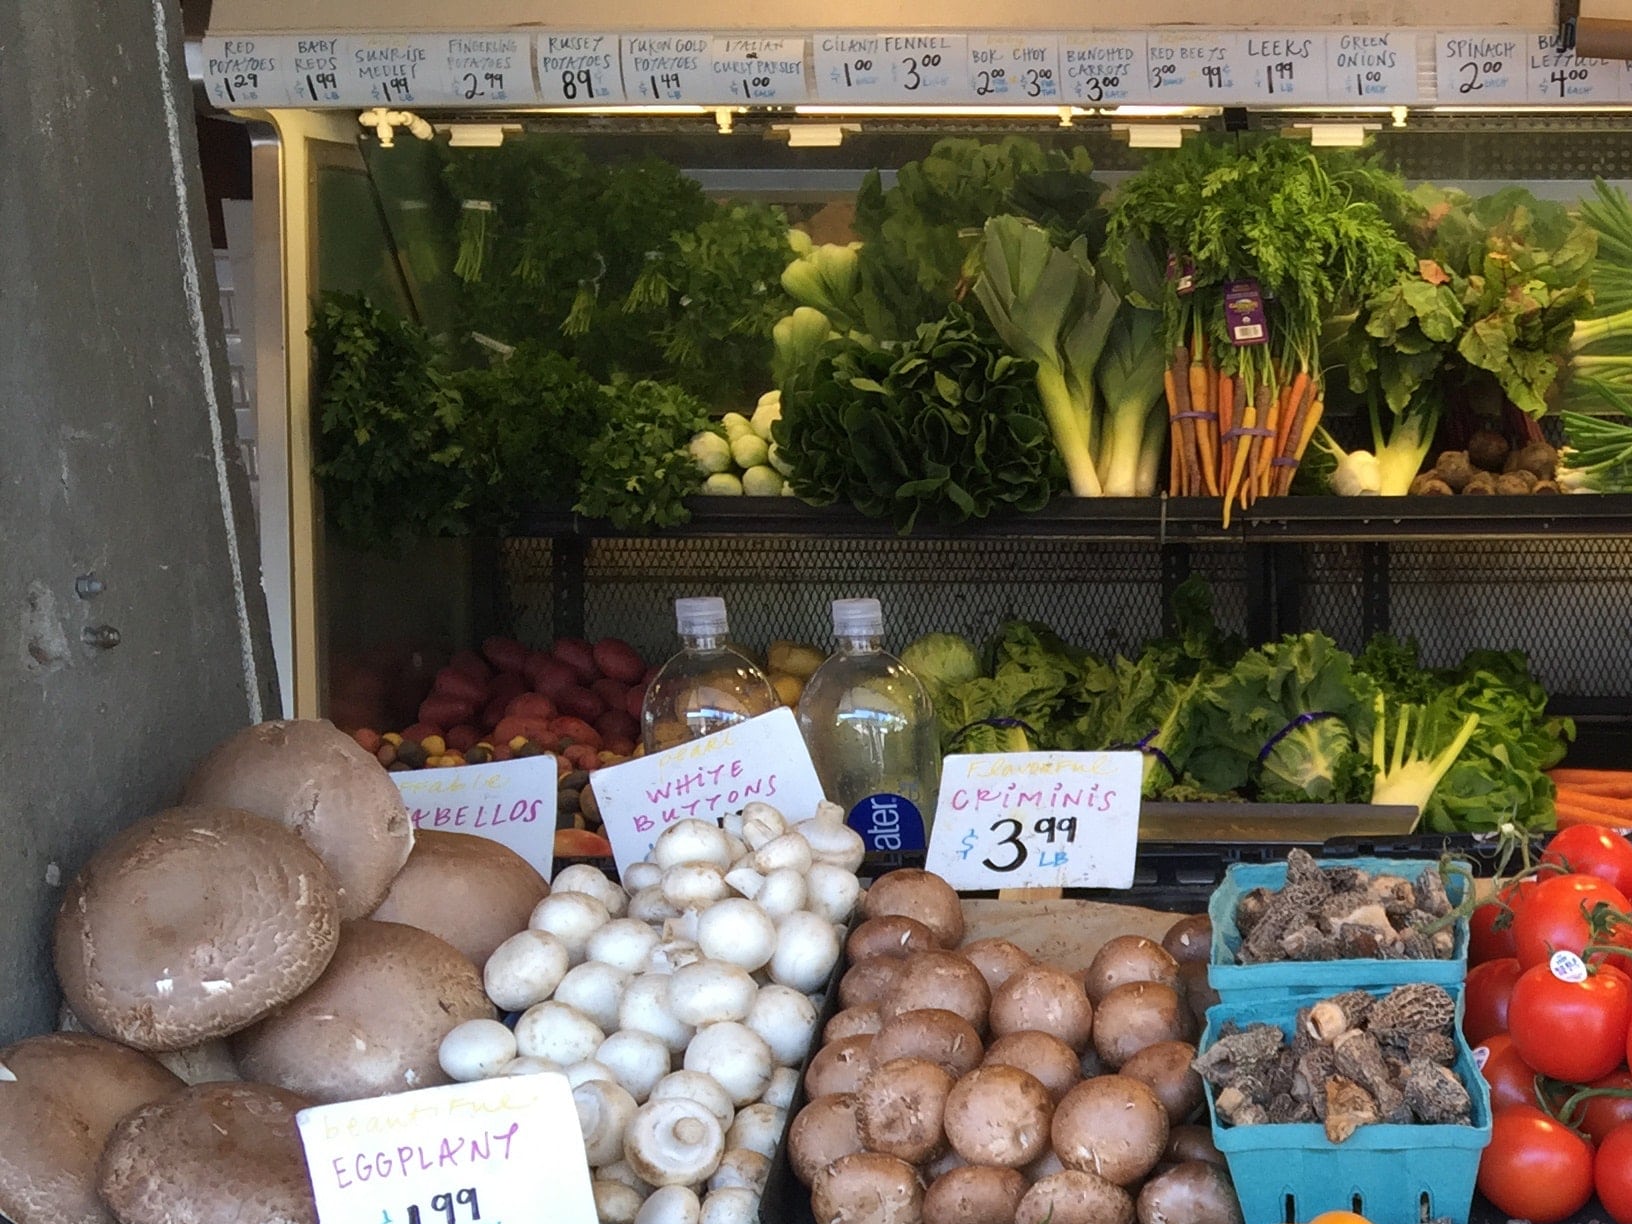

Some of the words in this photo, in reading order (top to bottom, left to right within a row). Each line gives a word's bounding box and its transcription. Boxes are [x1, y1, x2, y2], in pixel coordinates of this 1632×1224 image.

[224, 40, 254, 58] RED
[297, 39, 338, 55] BABY
[447, 40, 518, 54] FINGERLING
[549, 37, 604, 55] RUSSET
[629, 38, 665, 55] YUKON
[675, 38, 708, 54] GOLD
[886, 37, 951, 51] FENNEL
[1248, 40, 1312, 59] LEEKS
[1340, 33, 1391, 51] GREEN
[1447, 38, 1516, 59] SPINACH
[972, 49, 1003, 64] BOK
[1013, 47, 1047, 62] CHOY
[1067, 47, 1134, 63] BUNCHED
[1151, 48, 1175, 60] RED
[1337, 51, 1397, 69] ONIONS
[209, 58, 275, 76] POTATOES
[295, 57, 337, 72] REDS
[358, 63, 418, 79] MEDLEY
[447, 57, 512, 70] POTATOES
[544, 55, 611, 72] POTATOES
[634, 56, 697, 72] POTATOES
[757, 60, 802, 76] PARSLEY
[1069, 63, 1131, 78] CARROTS
[646, 760, 743, 804] WHITE
[633, 774, 776, 833] BUTTONS
[408, 799, 542, 829] ABELLOS
[1039, 851, 1069, 867] LB
[332, 1122, 519, 1189] EGGPLANT
